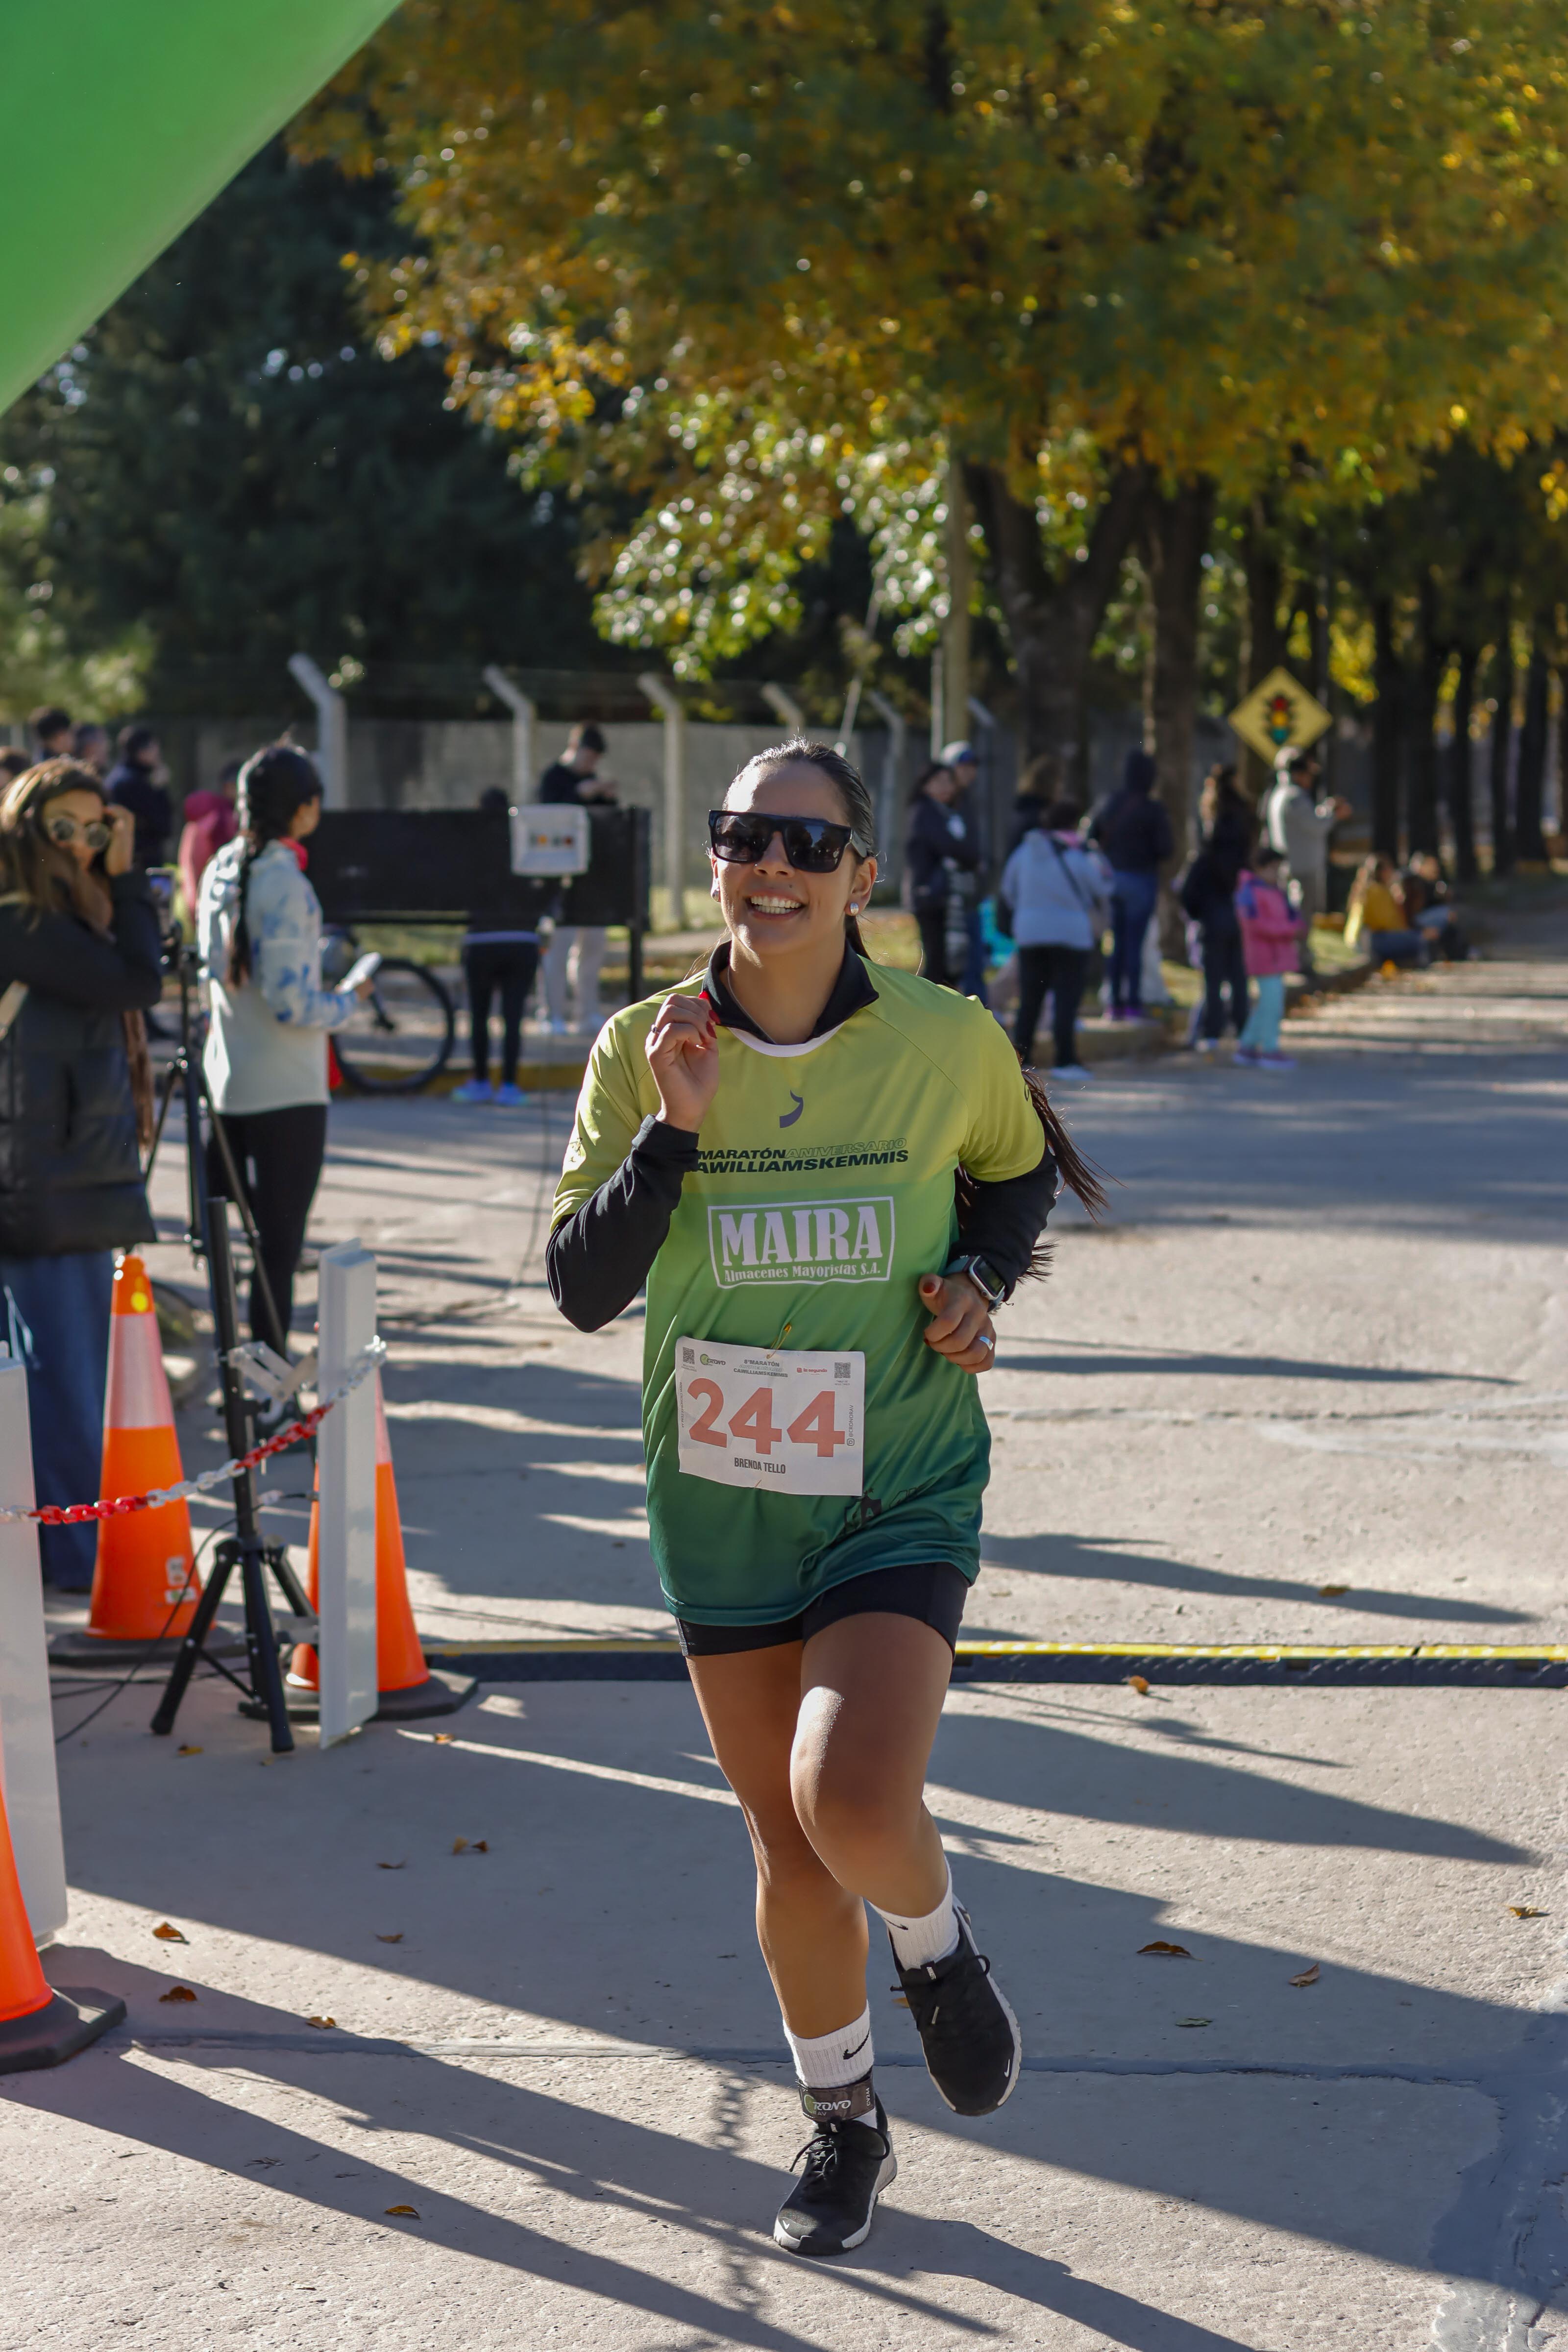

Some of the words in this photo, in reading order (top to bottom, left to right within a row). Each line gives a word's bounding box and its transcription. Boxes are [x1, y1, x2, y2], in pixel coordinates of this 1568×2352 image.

[784, 1138, 907, 1158] ANIVERSARIO
[698, 1150, 909, 1174] AWILLIAMSKEMMIS
[719, 1206, 882, 1267] MAIRA
[725, 1268, 788, 1282] Almacenes
[792, 1264, 857, 1278] Mayoristas
[860, 1262, 881, 1275] S.A.
[687, 1378, 845, 1457] 244
[735, 1457, 761, 1471] BRENDA
[763, 1462, 785, 1474] TELLO
